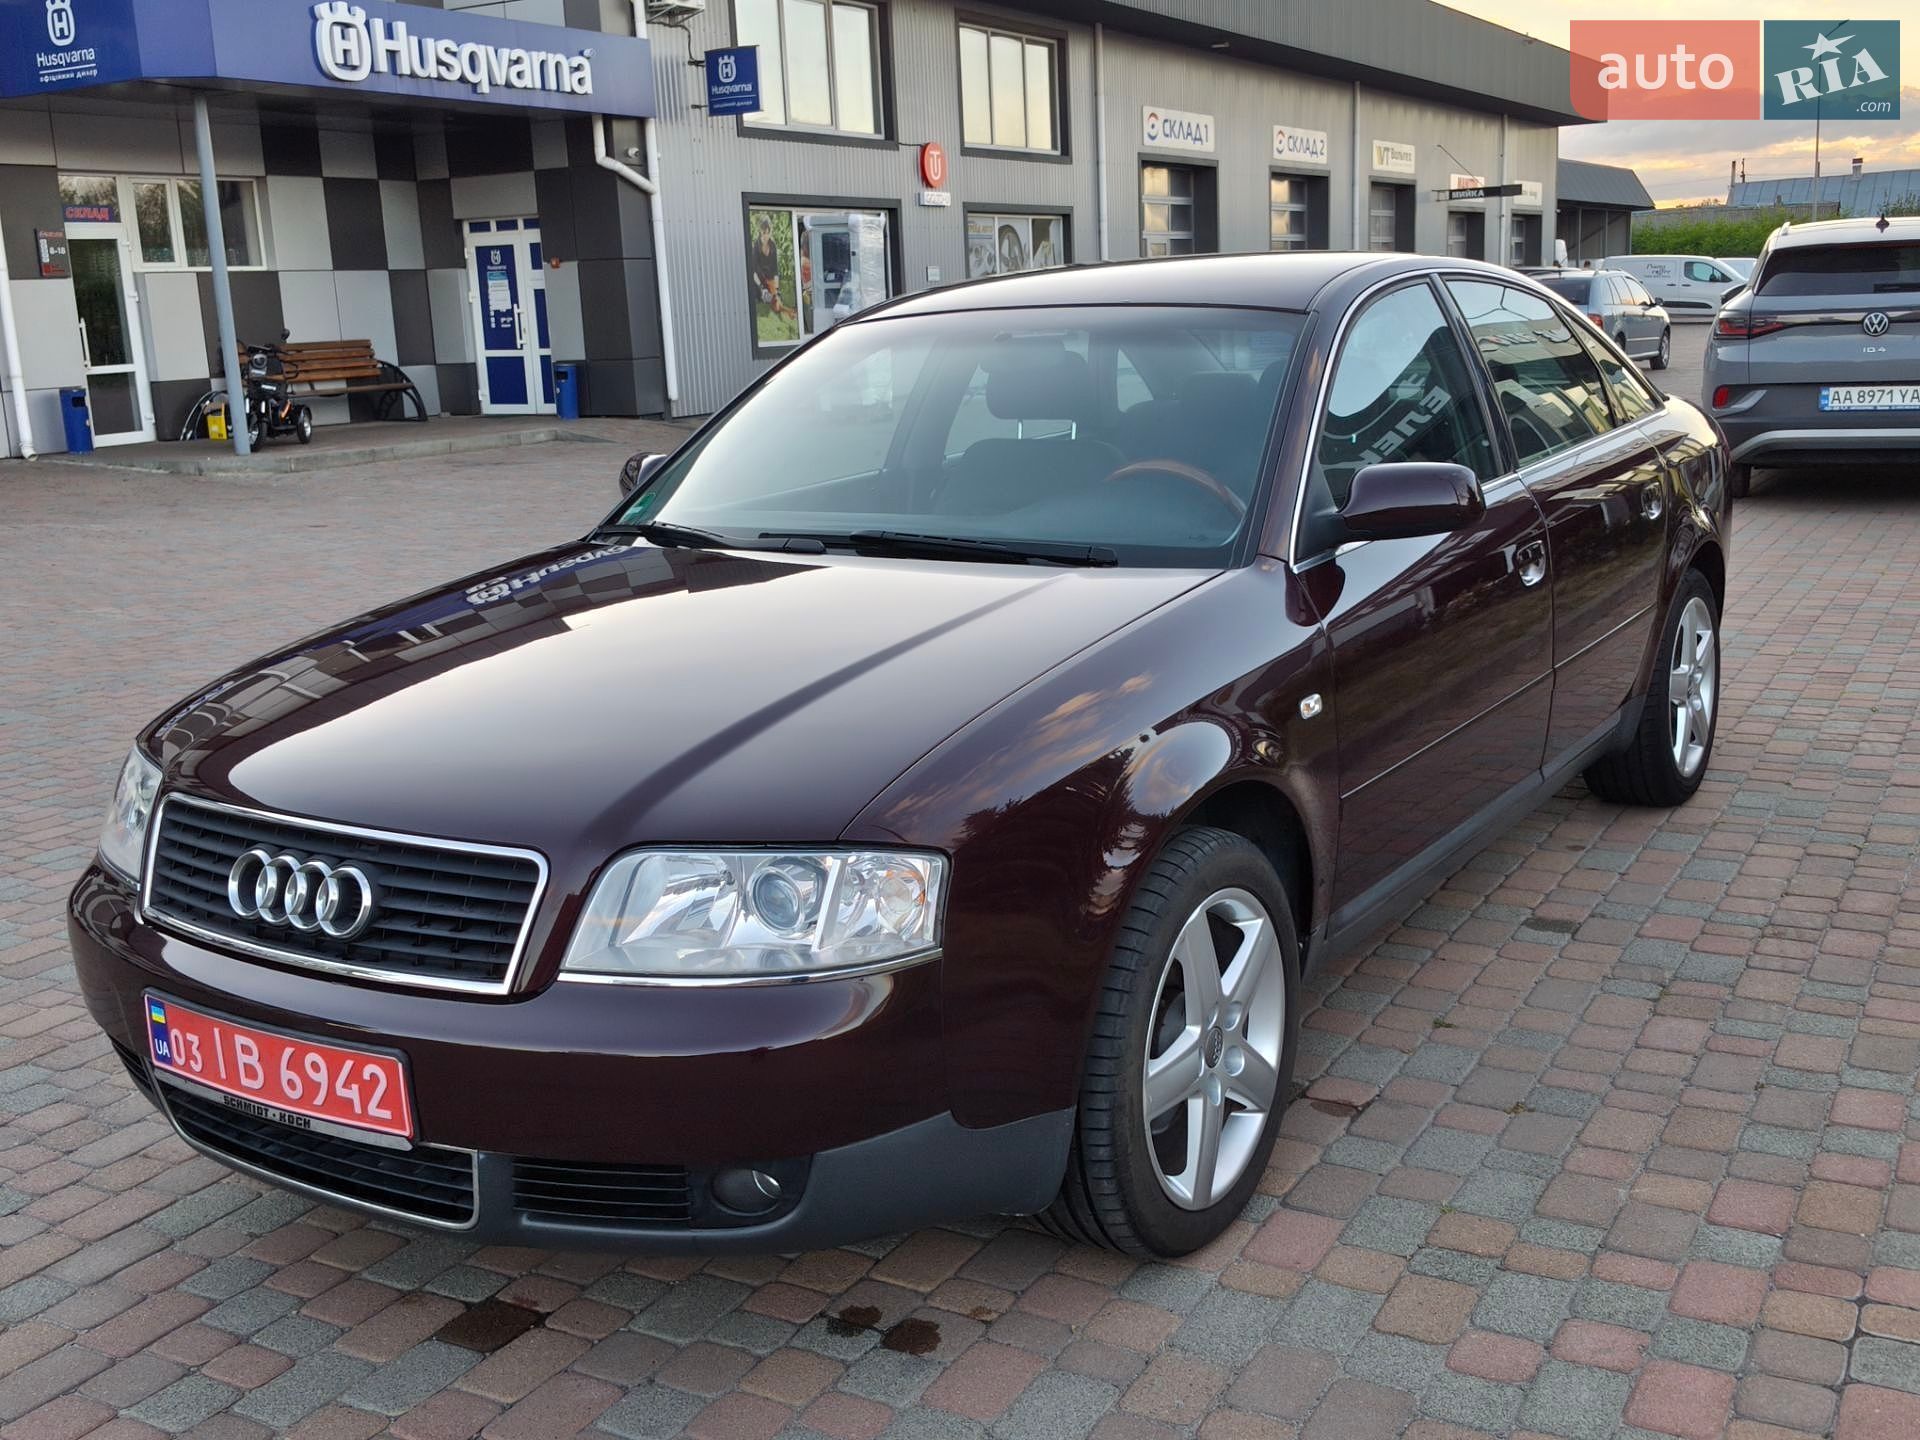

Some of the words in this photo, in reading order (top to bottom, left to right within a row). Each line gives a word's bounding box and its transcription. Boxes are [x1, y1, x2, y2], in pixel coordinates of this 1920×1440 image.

[36, 47, 97, 68] Husqvarna
[370, 17, 594, 95] Husqvarna
[711, 83, 753, 95] Husqvarna
[1162, 118, 1203, 146] СКЛАД
[1204, 123, 1209, 143] 1
[1287, 135, 1318, 158] СКЛАД
[1319, 139, 1325, 156] 2
[1451, 189, 1485, 200] МИЙКА
[65, 206, 109, 221] СКЛАД
[1831, 390, 1853, 404] AA
[1857, 389, 1894, 404] 8971
[1899, 388, 1920, 403] YA
[154, 1039, 171, 1058] UA
[170, 1028, 203, 1073] 03
[279, 1047, 393, 1120] 6942
[223, 1095, 270, 1118] SCHMIDT
[279, 1112, 311, 1129] KOCH
